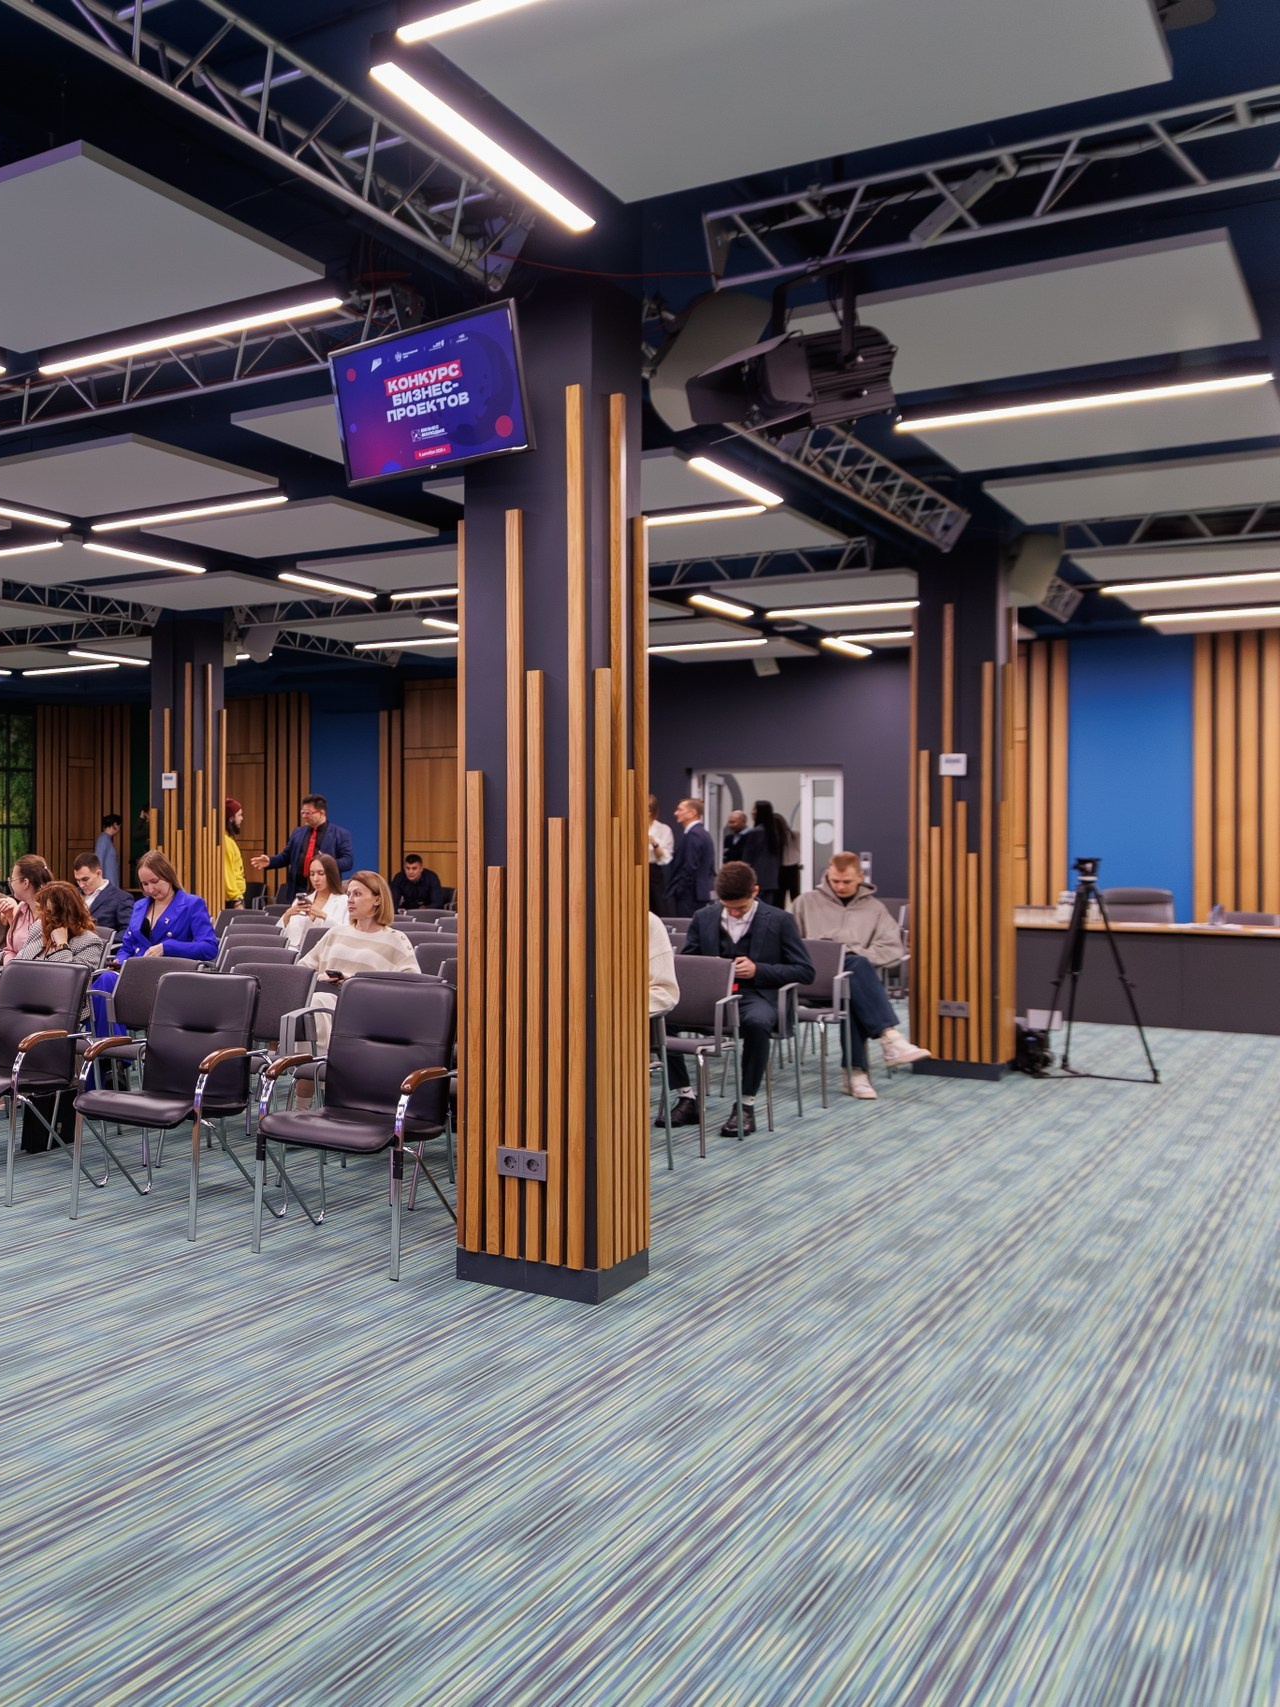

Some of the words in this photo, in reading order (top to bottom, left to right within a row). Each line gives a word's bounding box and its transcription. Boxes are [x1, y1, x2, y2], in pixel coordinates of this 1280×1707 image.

[387, 363, 460, 394] КОНКУРС
[392, 380, 459, 407] БИЗНЕС-
[386, 391, 470, 422] ПРОЕКТОВ
